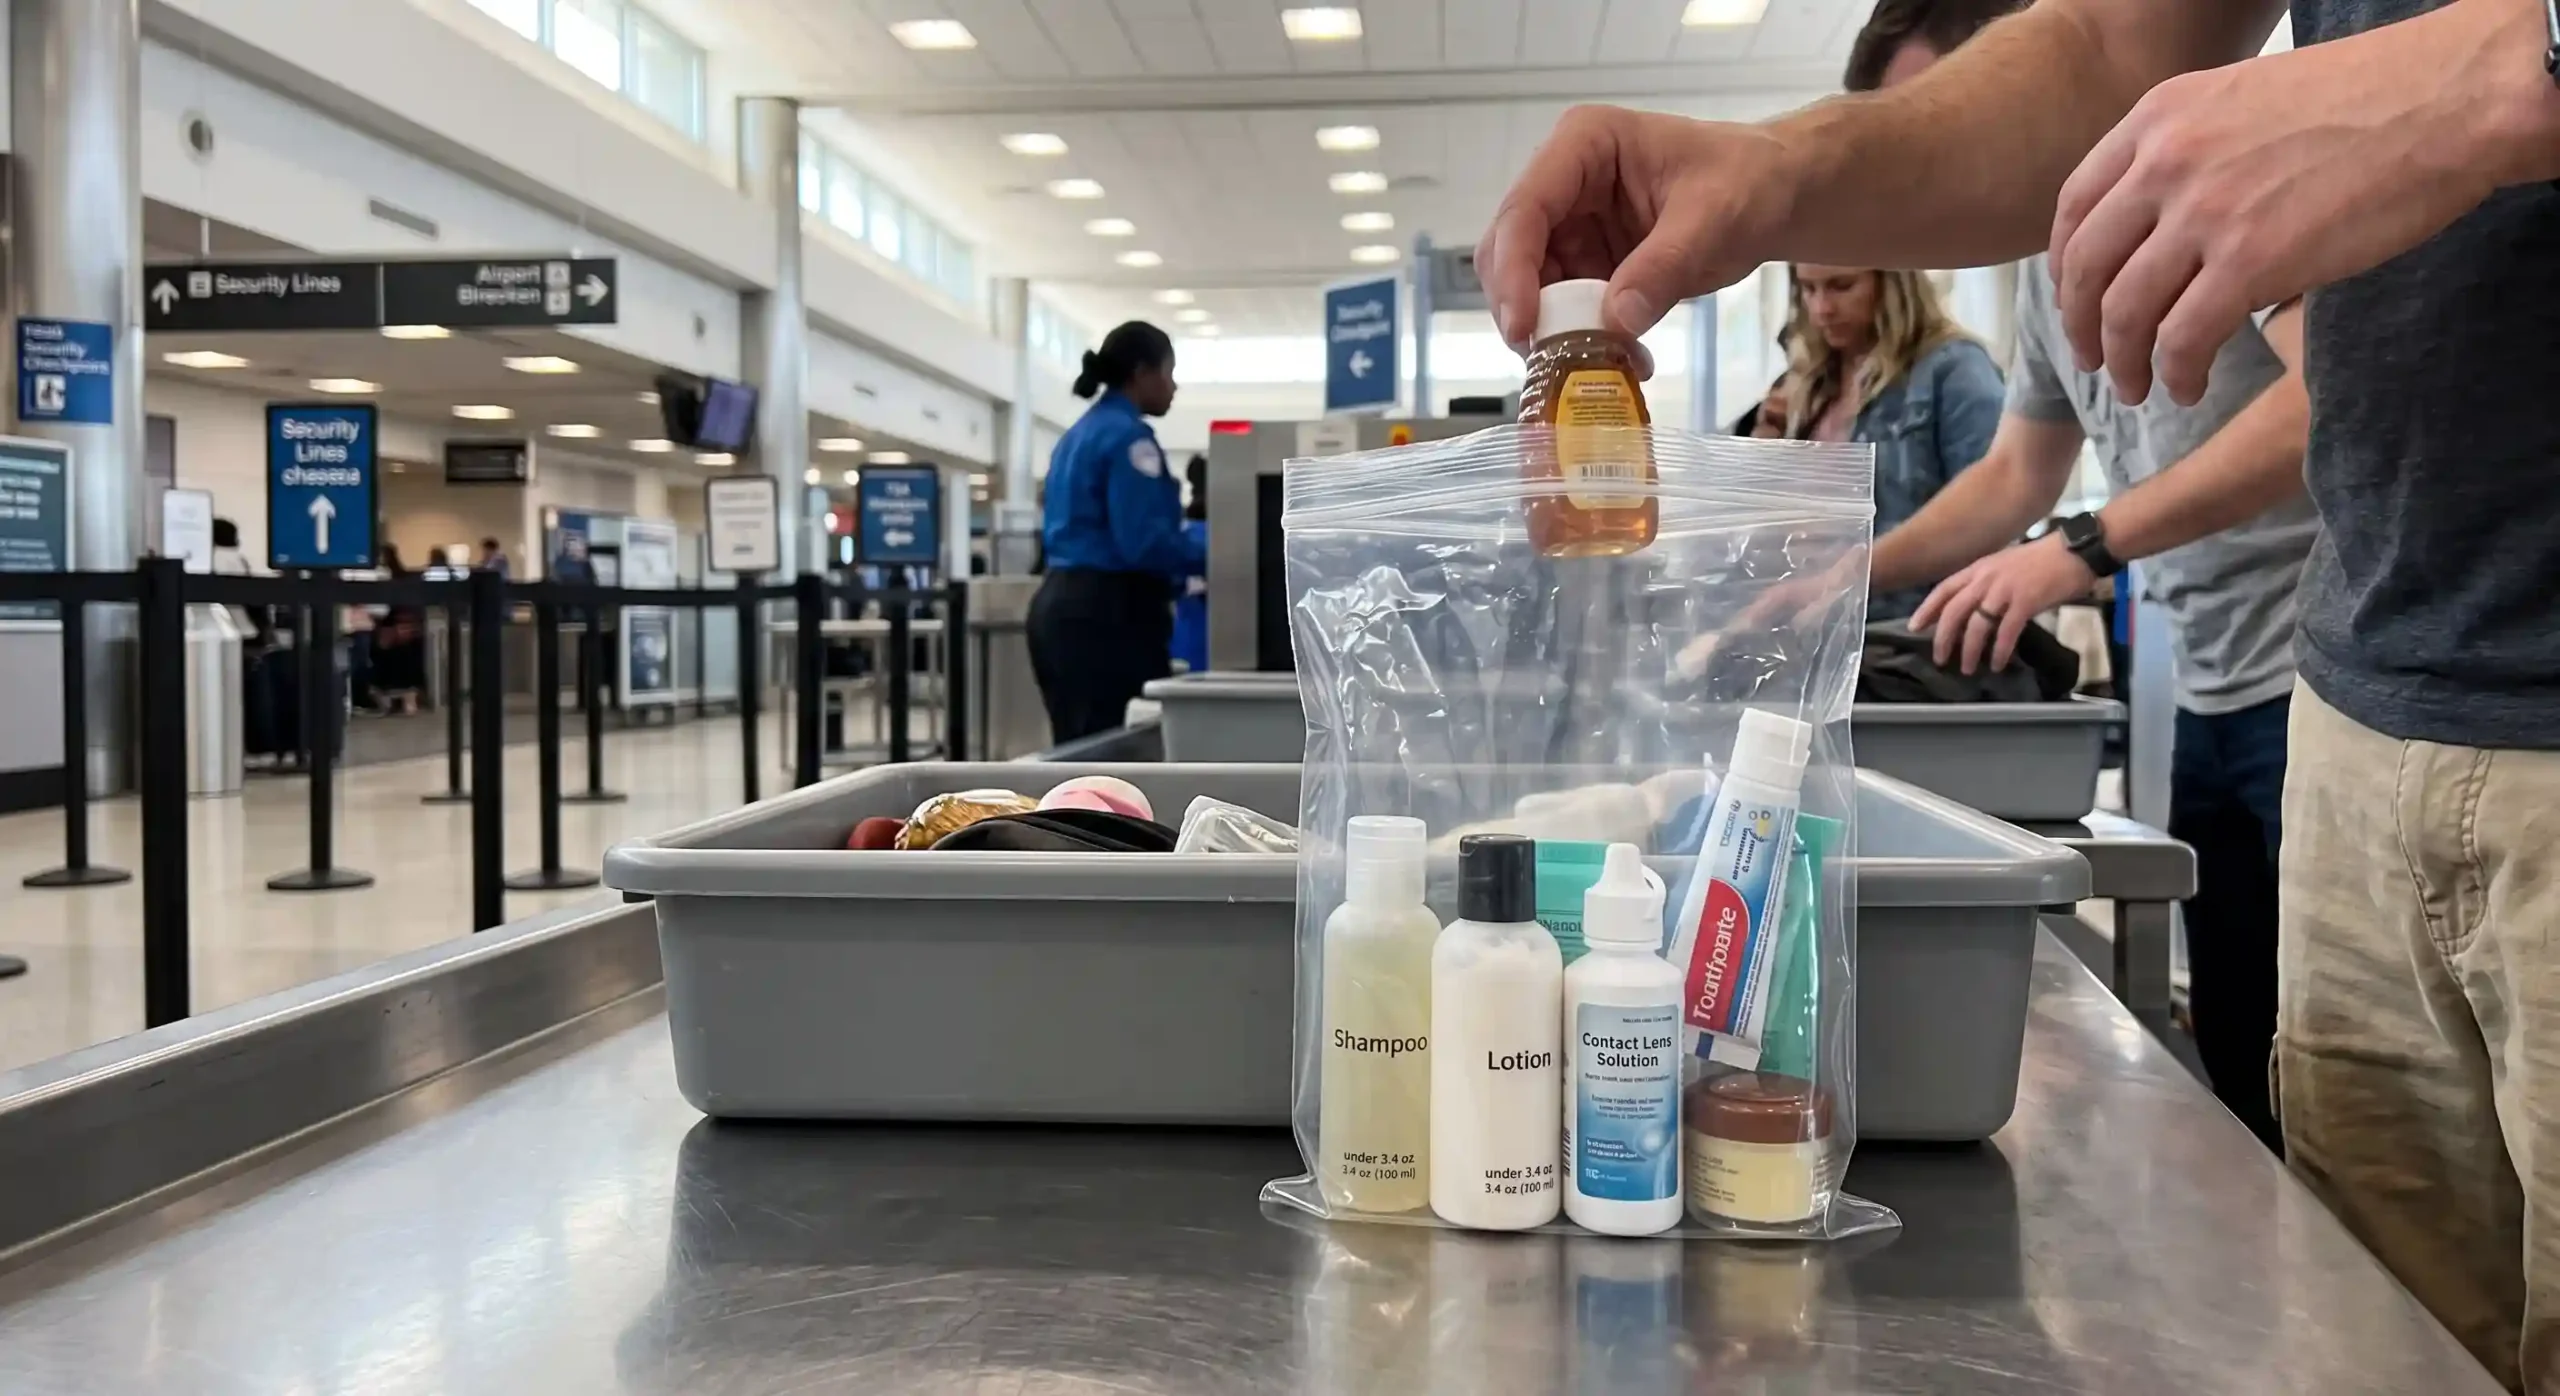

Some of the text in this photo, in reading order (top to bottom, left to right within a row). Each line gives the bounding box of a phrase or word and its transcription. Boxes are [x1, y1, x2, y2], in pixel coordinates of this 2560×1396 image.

[215, 273, 341, 298] Security Lines
[281, 418, 360, 443] Security
[295, 442, 347, 462] Lines
[1334, 1028, 1428, 1058] Shampoo
[1582, 1032, 1672, 1050] Contact Lens
[1488, 1050, 1551, 1071] Lotion
[1597, 1052, 1659, 1068] Solution
[1344, 1152, 1415, 1165] under 3.4 oz
[1359, 1169, 1371, 1178] oz
[1375, 1168, 1398, 1181] (100
[1400, 1167, 1416, 1180] ml)
[1485, 1167, 1522, 1179] under
[1525, 1166, 1541, 1178] 3.4
[1485, 1183, 1501, 1194] 3.4
[1504, 1186, 1517, 1194] oz
[1520, 1181, 1541, 1196] (100
